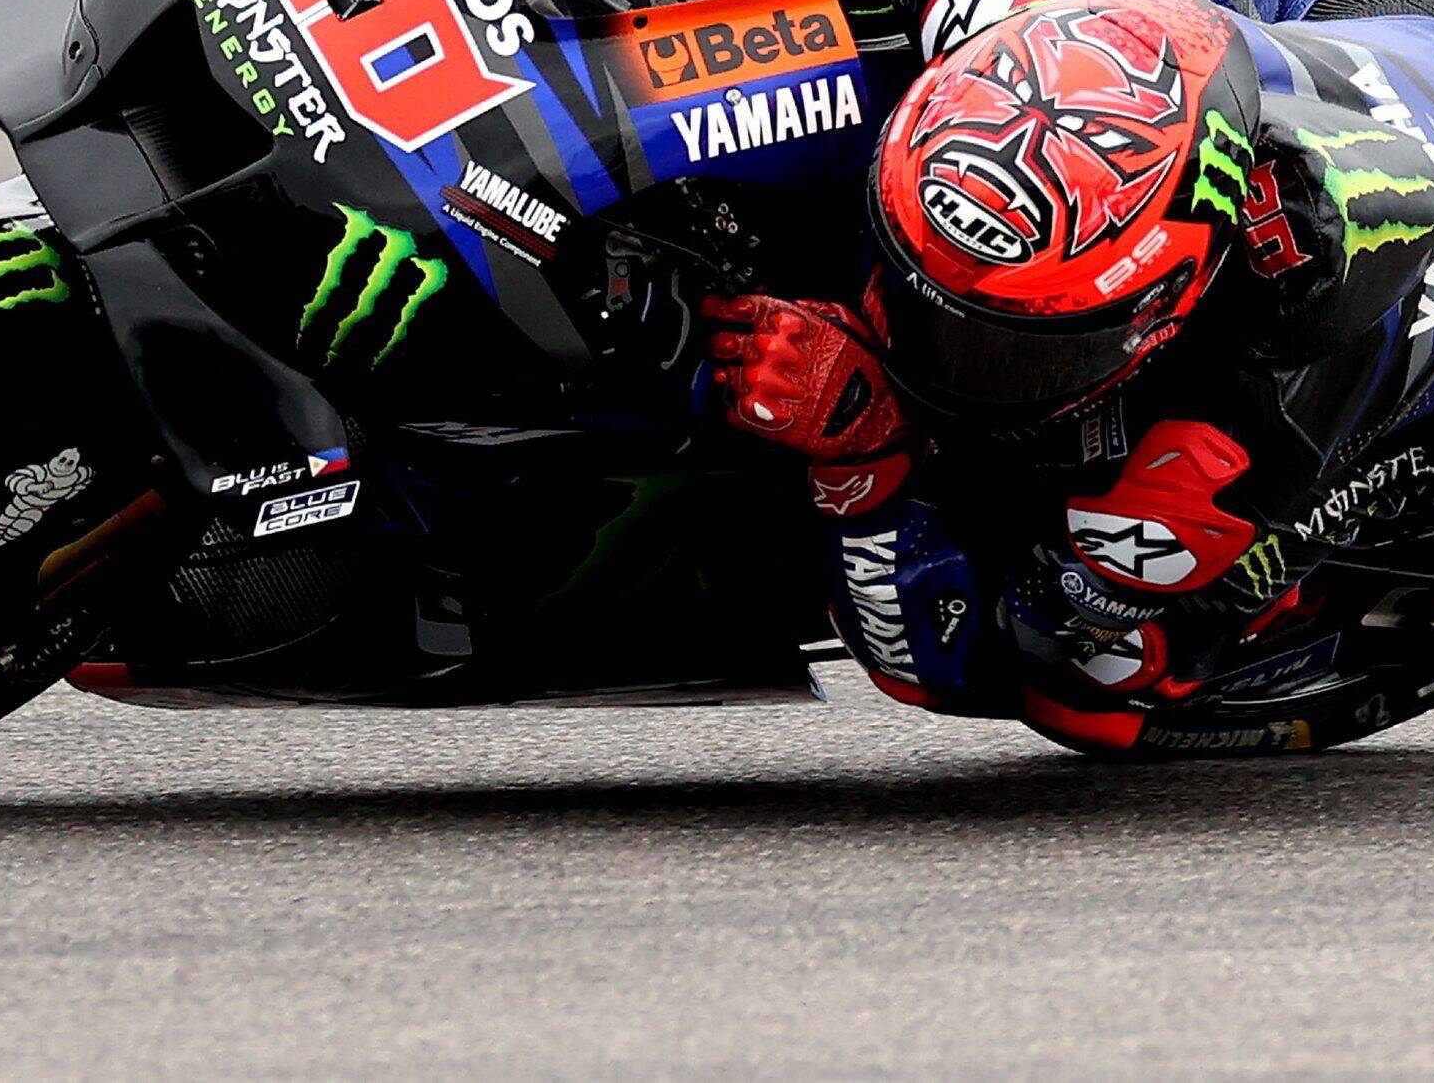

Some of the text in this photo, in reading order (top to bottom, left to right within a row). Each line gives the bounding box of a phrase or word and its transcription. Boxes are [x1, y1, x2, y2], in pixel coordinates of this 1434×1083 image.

[701, 10, 839, 74] Beta
[671, 74, 863, 162] YAMAHA
[460, 160, 567, 242] YAMALUBE
[927, 189, 1020, 255] HJC
[211, 467, 266, 493] BLU
[241, 467, 306, 496] FAST
[270, 486, 348, 515] BLUE
[266, 504, 343, 531] CORE
